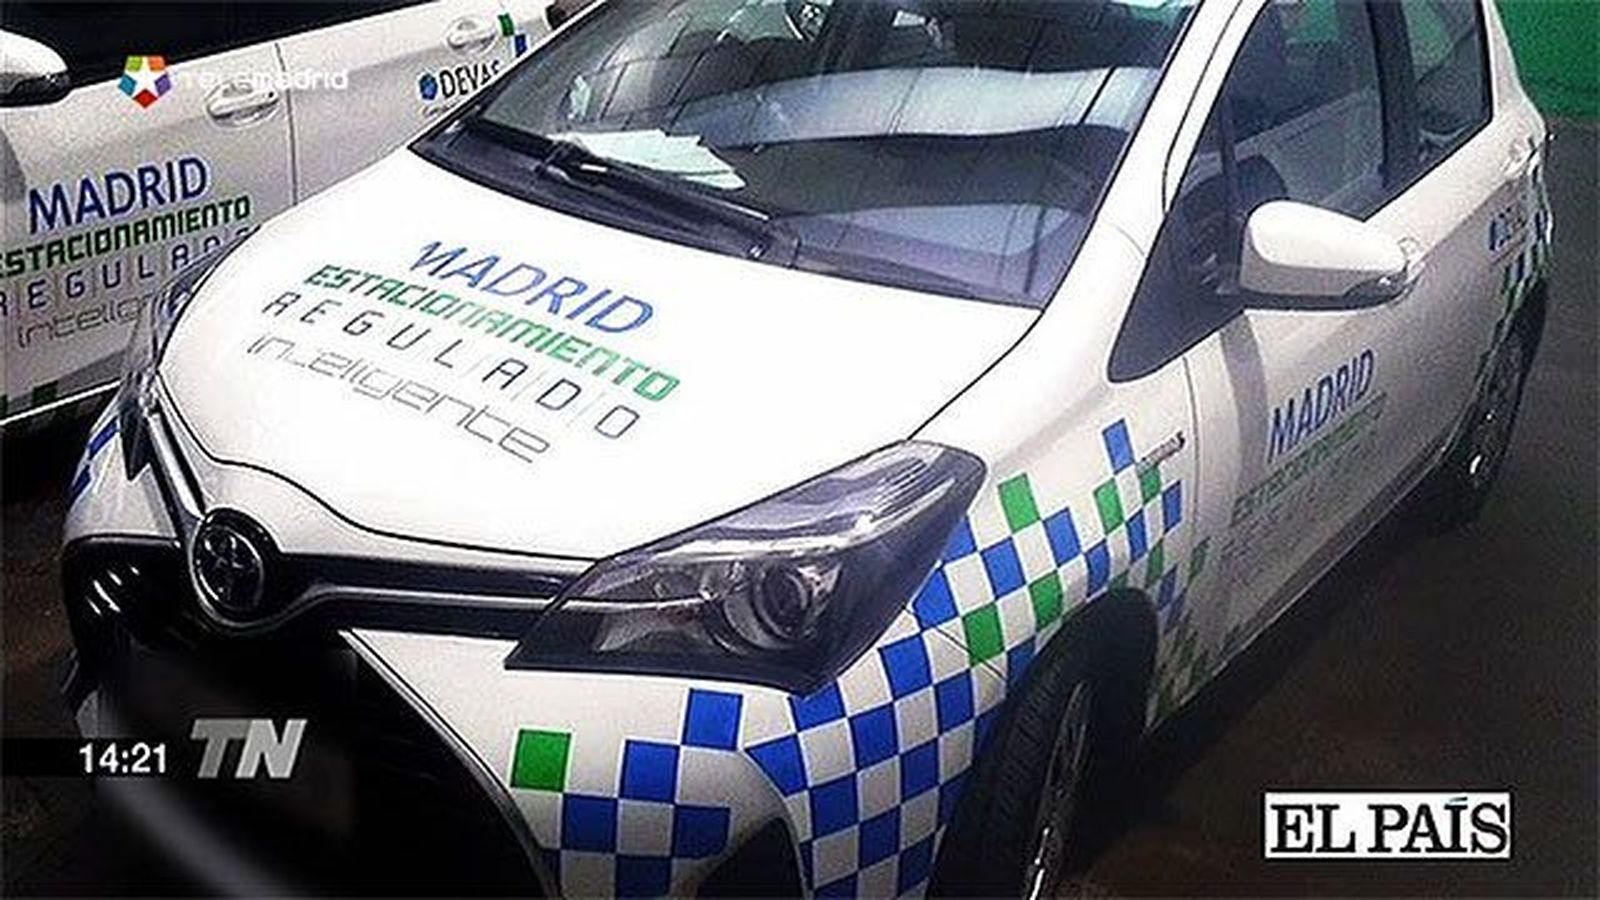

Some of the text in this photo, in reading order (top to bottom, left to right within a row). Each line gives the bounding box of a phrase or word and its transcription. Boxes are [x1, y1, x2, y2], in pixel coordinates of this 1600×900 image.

[29, 157, 208, 236] MADRID
[304, 264, 681, 402] ESTACIONAMIENTO
[408, 241, 653, 333] MADRID
[262, 291, 640, 439] REGULADO
[1268, 349, 1374, 464] MADRID
